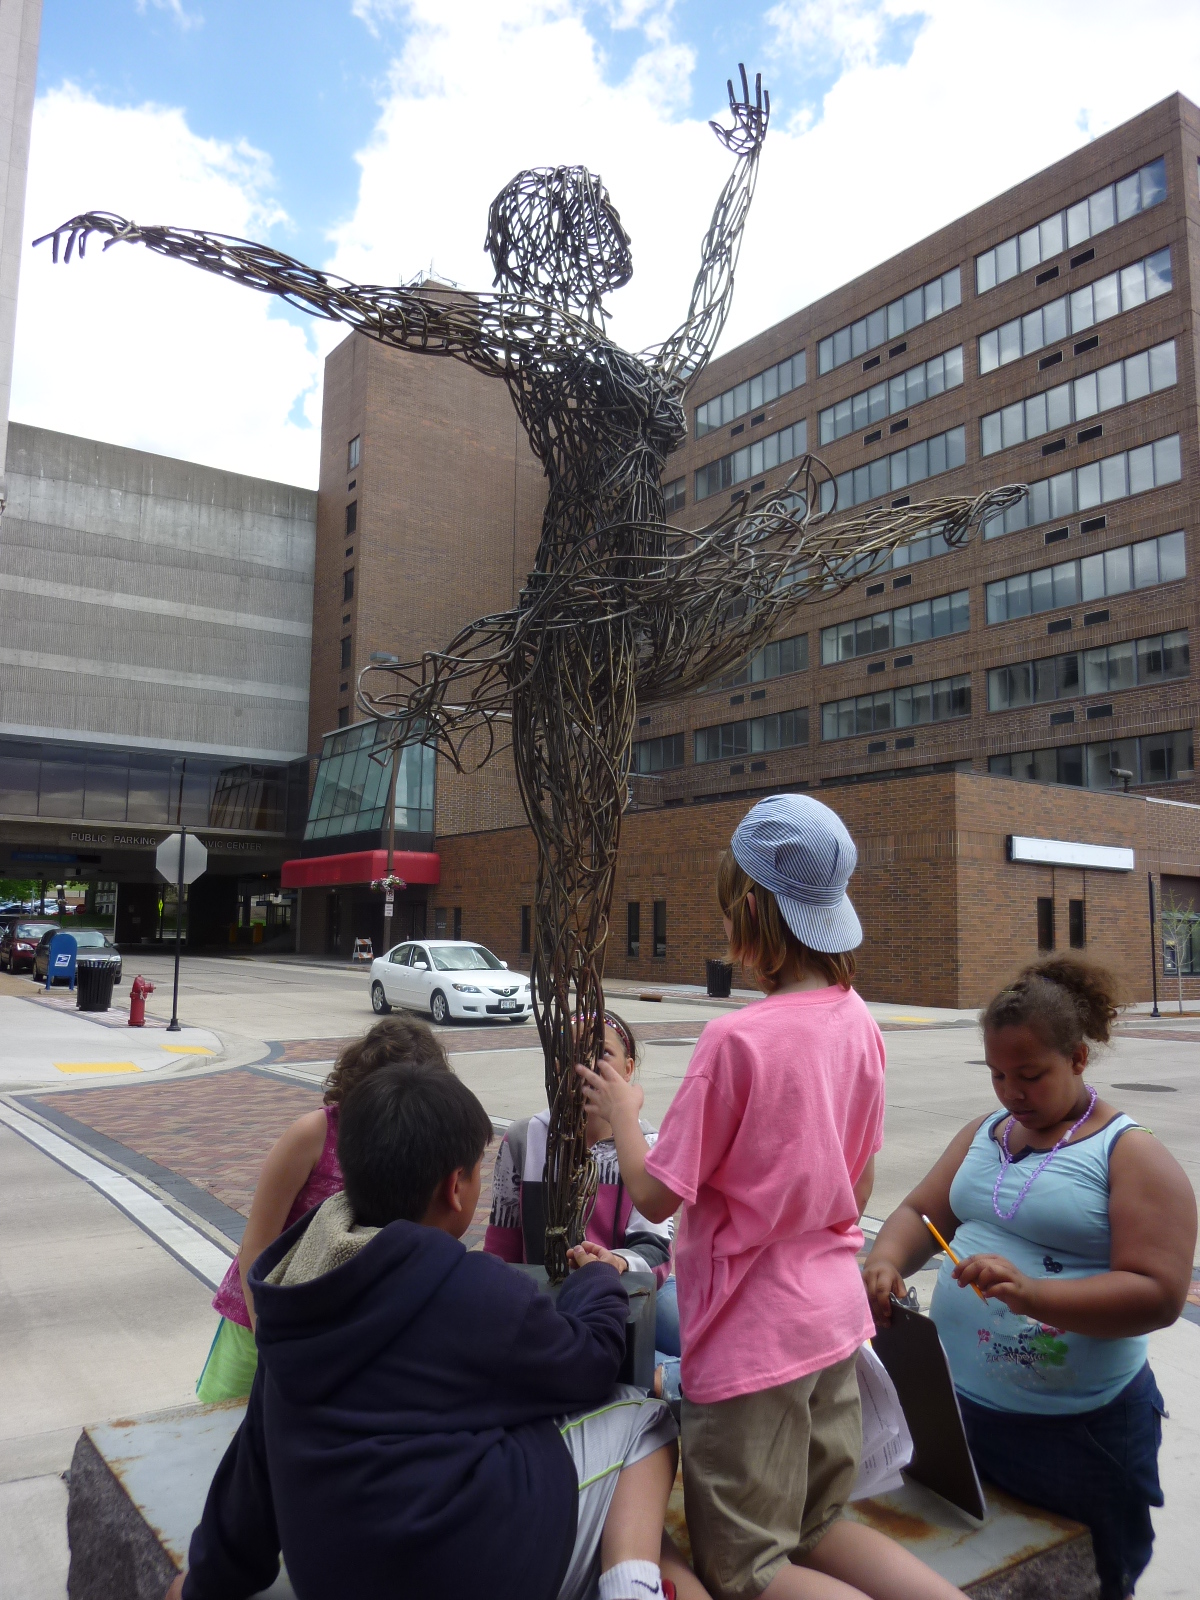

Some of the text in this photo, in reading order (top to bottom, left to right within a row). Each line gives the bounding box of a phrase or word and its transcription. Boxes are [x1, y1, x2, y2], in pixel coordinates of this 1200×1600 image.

[70, 832, 107, 843] PUBLIC
[113, 835, 156, 846] PARKING
[226, 841, 262, 851] CENTER
